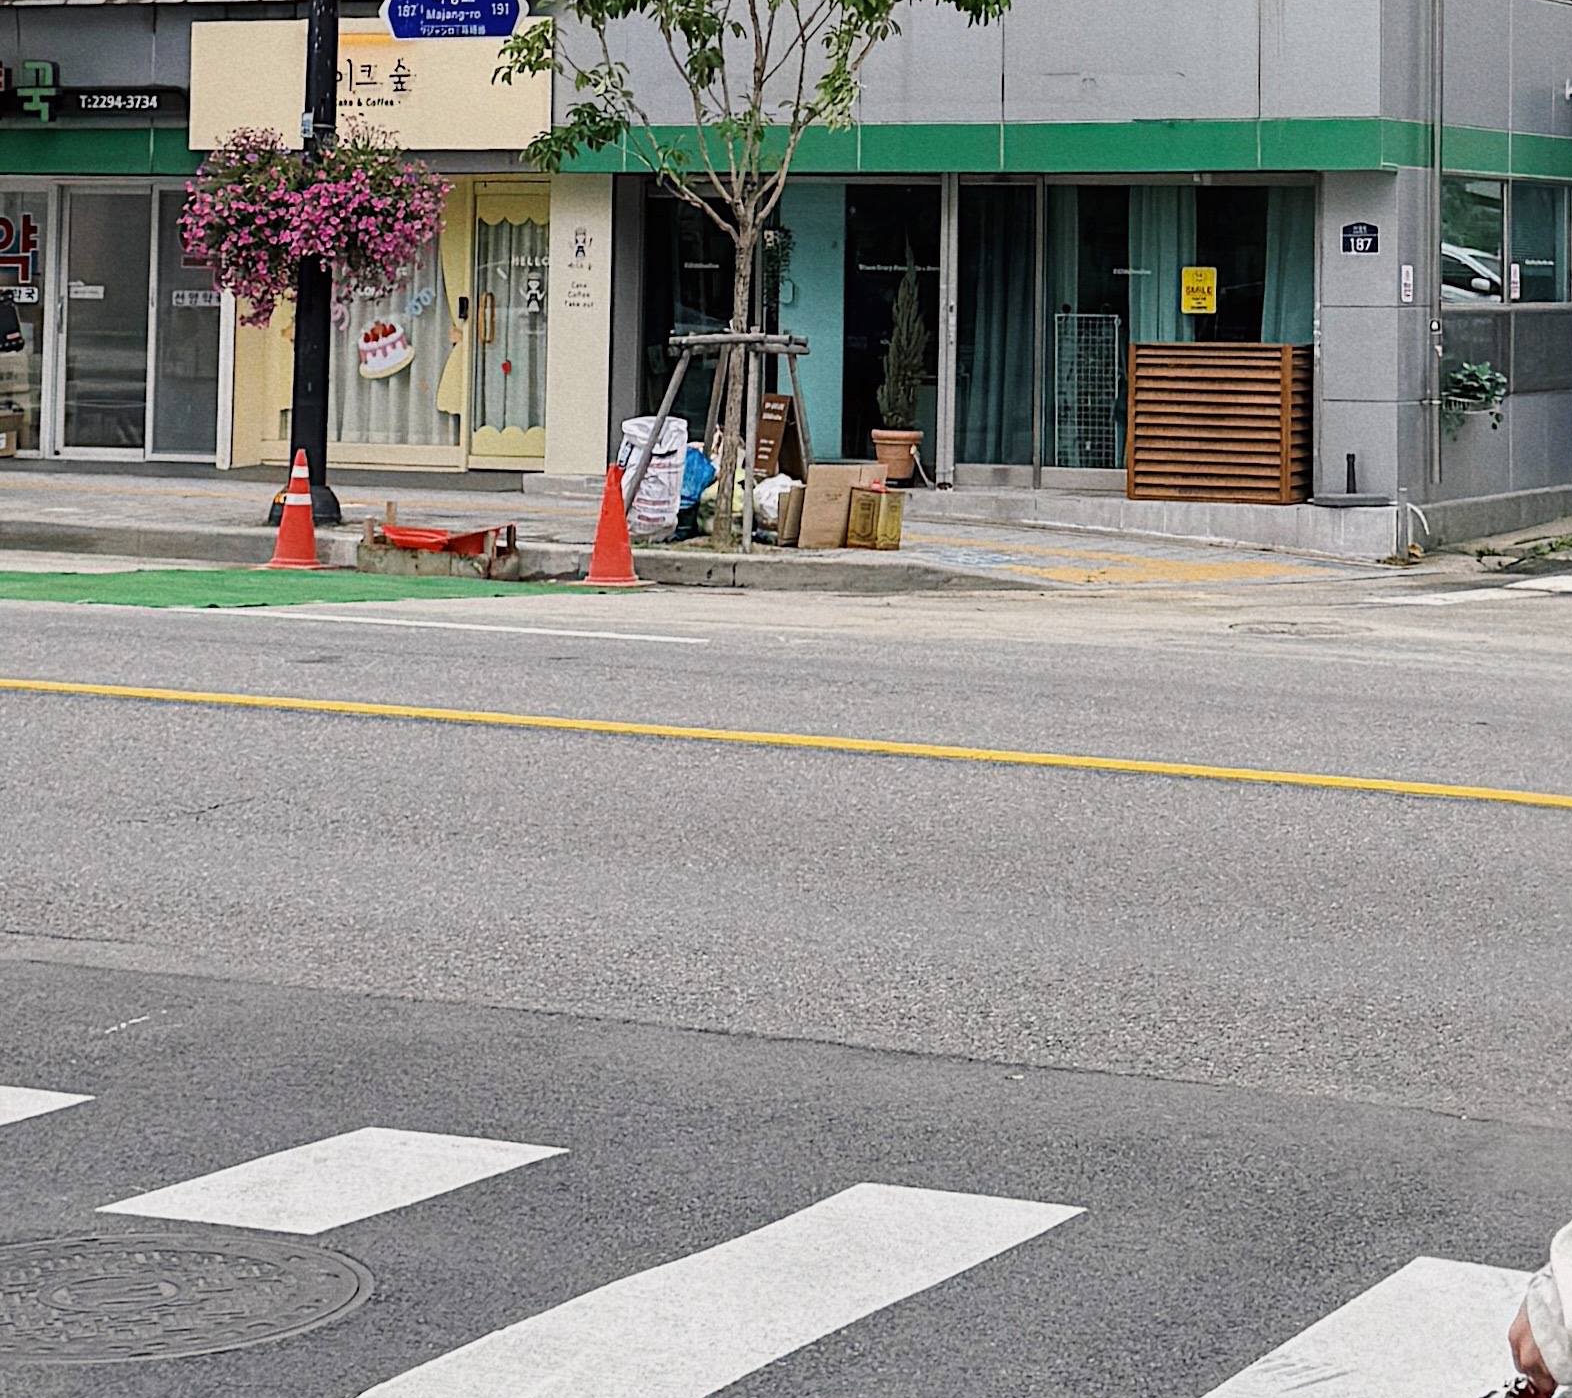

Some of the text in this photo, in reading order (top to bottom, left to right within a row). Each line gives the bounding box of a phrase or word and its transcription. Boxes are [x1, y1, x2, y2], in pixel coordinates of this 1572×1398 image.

[397, 3, 510, 22] 187 Majang-ro 191
[336, 58, 378, 92] 이크
[0, 60, 57, 122] 국
[1350, 237, 1373, 251] 187
[512, 255, 549, 267] HELLO
